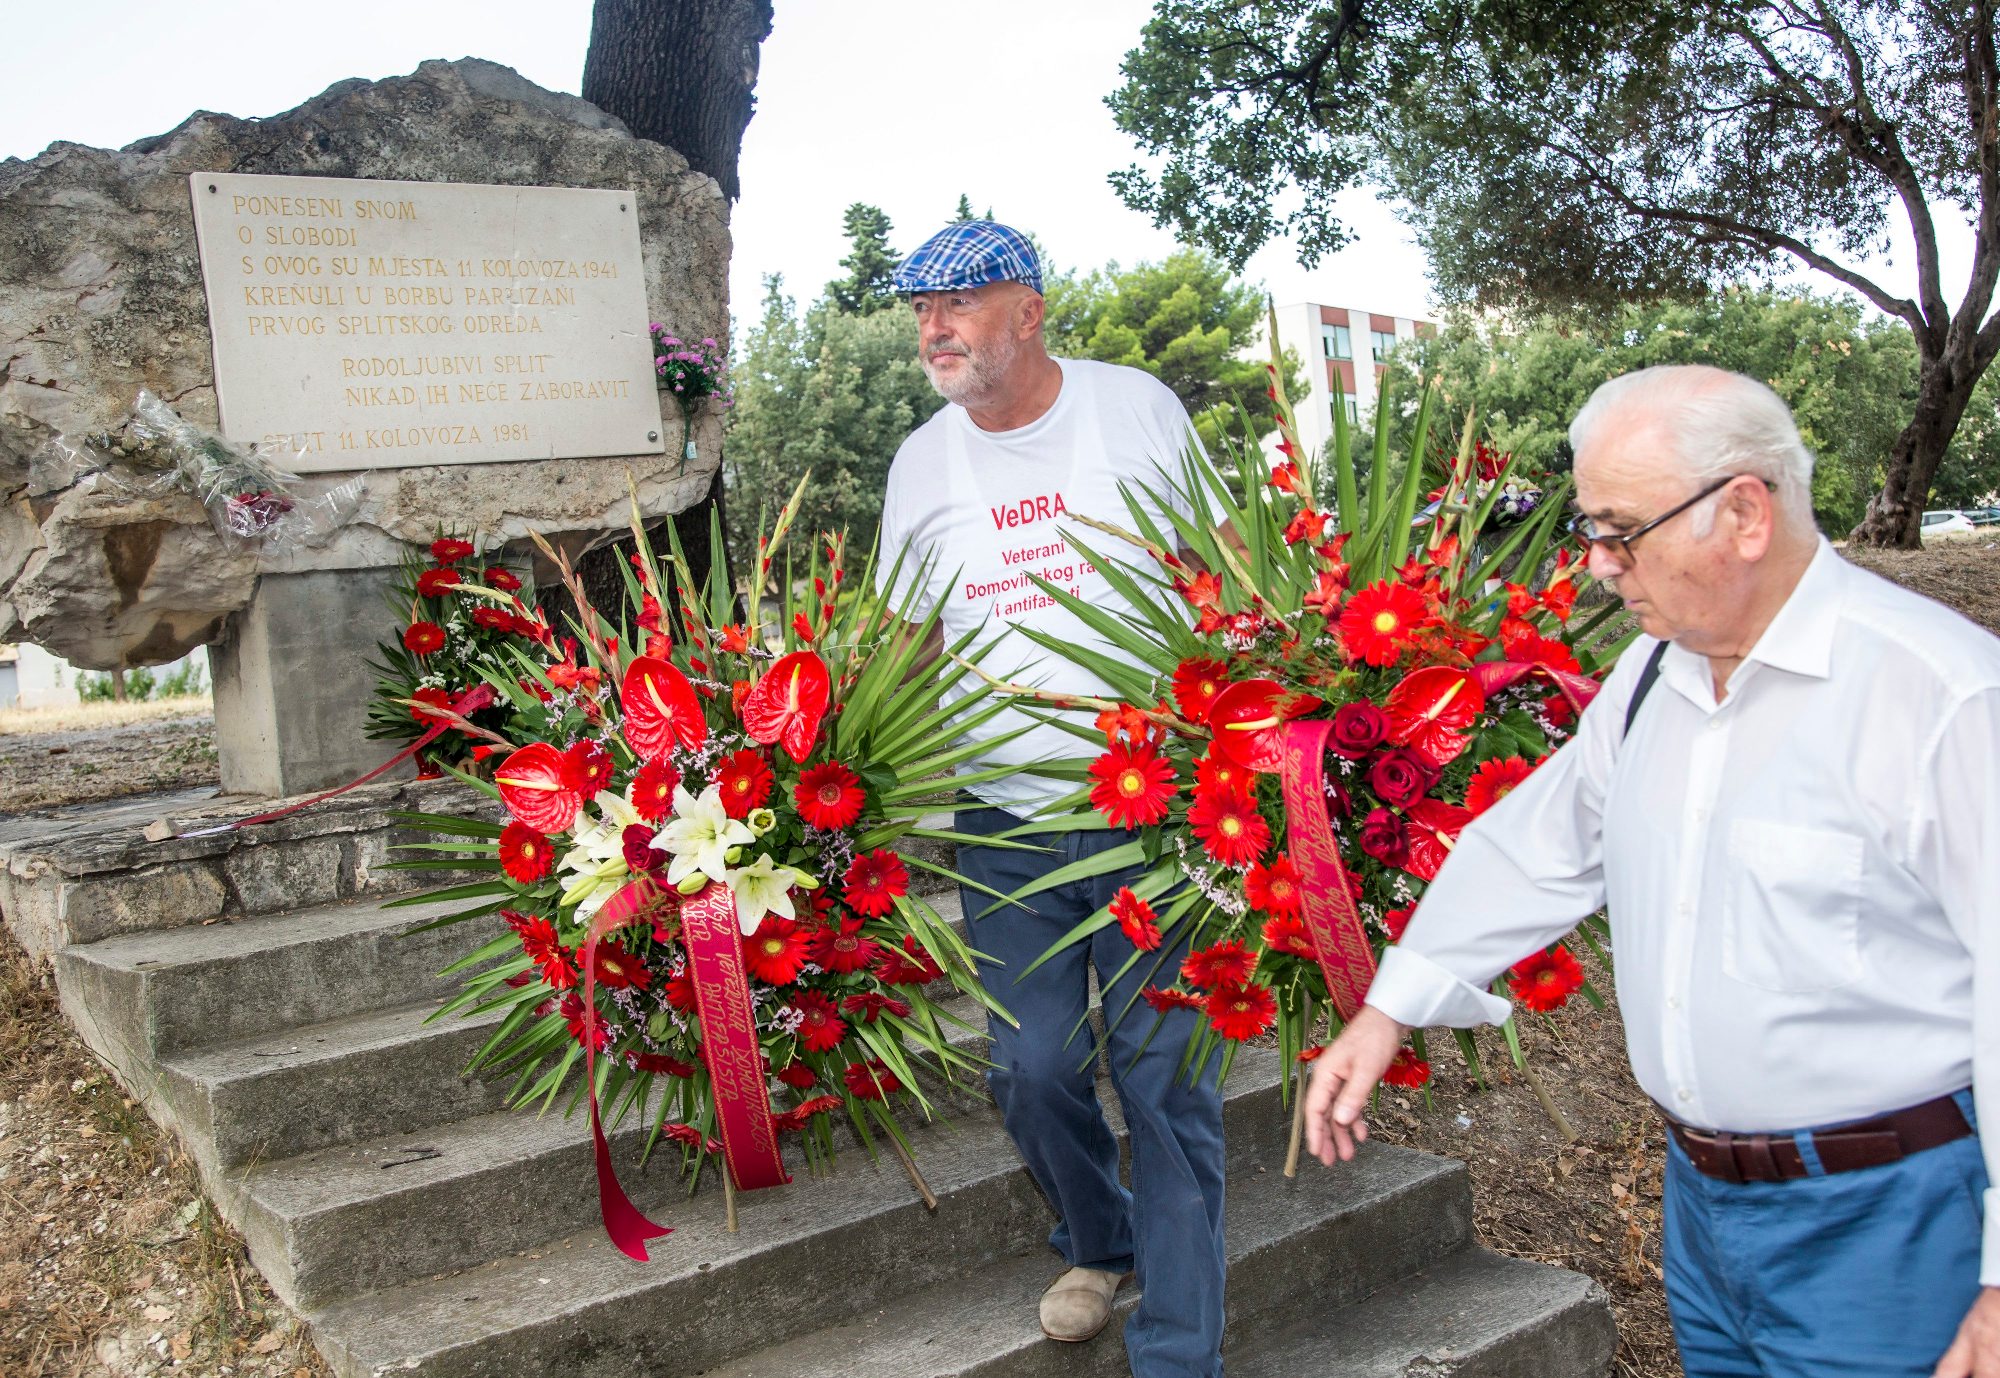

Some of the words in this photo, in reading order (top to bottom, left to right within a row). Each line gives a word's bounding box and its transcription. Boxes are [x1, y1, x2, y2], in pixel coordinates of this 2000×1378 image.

[232, 196, 342, 218] PONESENI
[356, 201, 417, 220] SNOM
[239, 226, 252, 244] O
[267, 226, 357, 247] SLOBODI
[242, 256, 254, 276] S
[265, 257, 321, 276] OVOG
[332, 258, 358, 276] SU
[369, 258, 448, 277] MJESTA
[483, 260, 579, 279] KOLOVOZA
[582, 261, 617, 279] 1941
[244, 286, 343, 306] KRENULI
[355, 286, 371, 305] U
[386, 288, 453, 305] BORBU
[249, 316, 325, 335] PRVOG
[339, 315, 454, 334] SPLITSKOG
[464, 315, 543, 333] ODREDA
[342, 357, 481, 377] RODOLJUBIVI
[494, 355, 547, 372] SPLIT
[346, 387, 416, 407] NIKAD
[428, 384, 450, 405] IH
[520, 380, 629, 401] ZABORAVIT
[367, 426, 482, 448] KOLOVOZA
[493, 425, 528, 441] 1981
[991, 492, 1066, 531] VeDRA
[1002, 538, 1065, 566] Veterani
[966, 562, 1074, 600] Domovinkog
[1004, 585, 1080, 615] antifati
